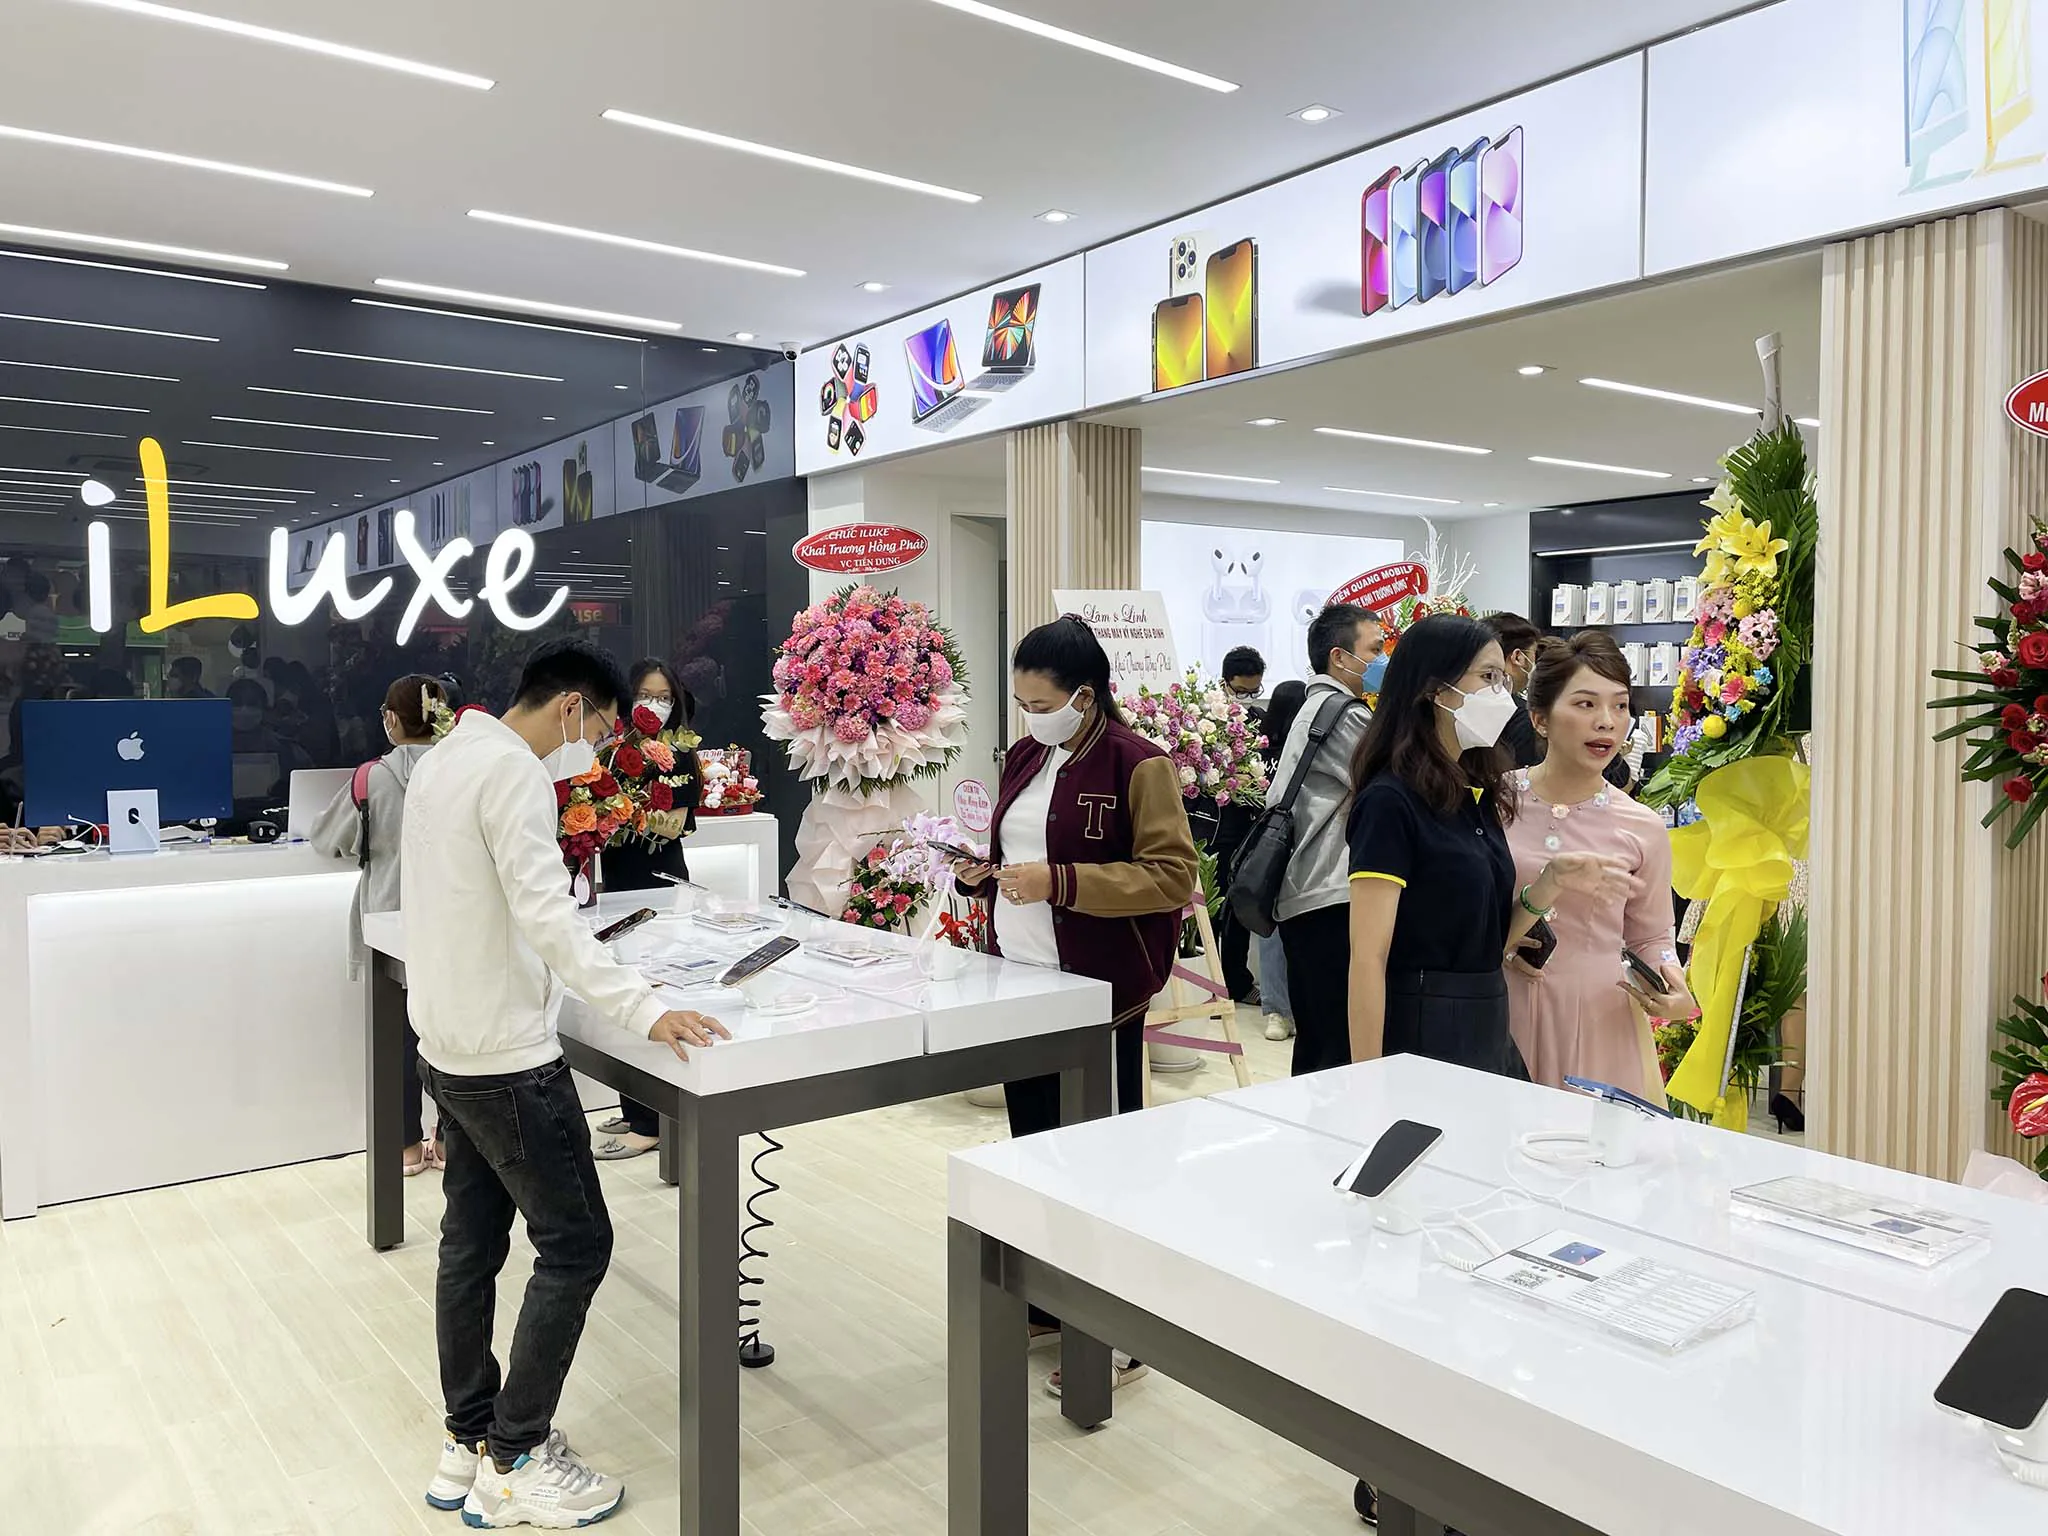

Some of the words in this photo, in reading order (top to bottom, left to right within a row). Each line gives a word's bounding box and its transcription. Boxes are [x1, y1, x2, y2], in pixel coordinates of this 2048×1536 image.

[81, 436, 570, 646] iLuxe
[801, 545, 826, 557] Khai
[829, 543, 865, 555] Trương
[868, 538, 897, 553] Hồng
[899, 538, 925, 550] Phát
[840, 560, 853, 568] VC
[1351, 573, 1381, 592] QUANG
[1121, 603, 1148, 624] Linh
[1077, 793, 1117, 840] T
